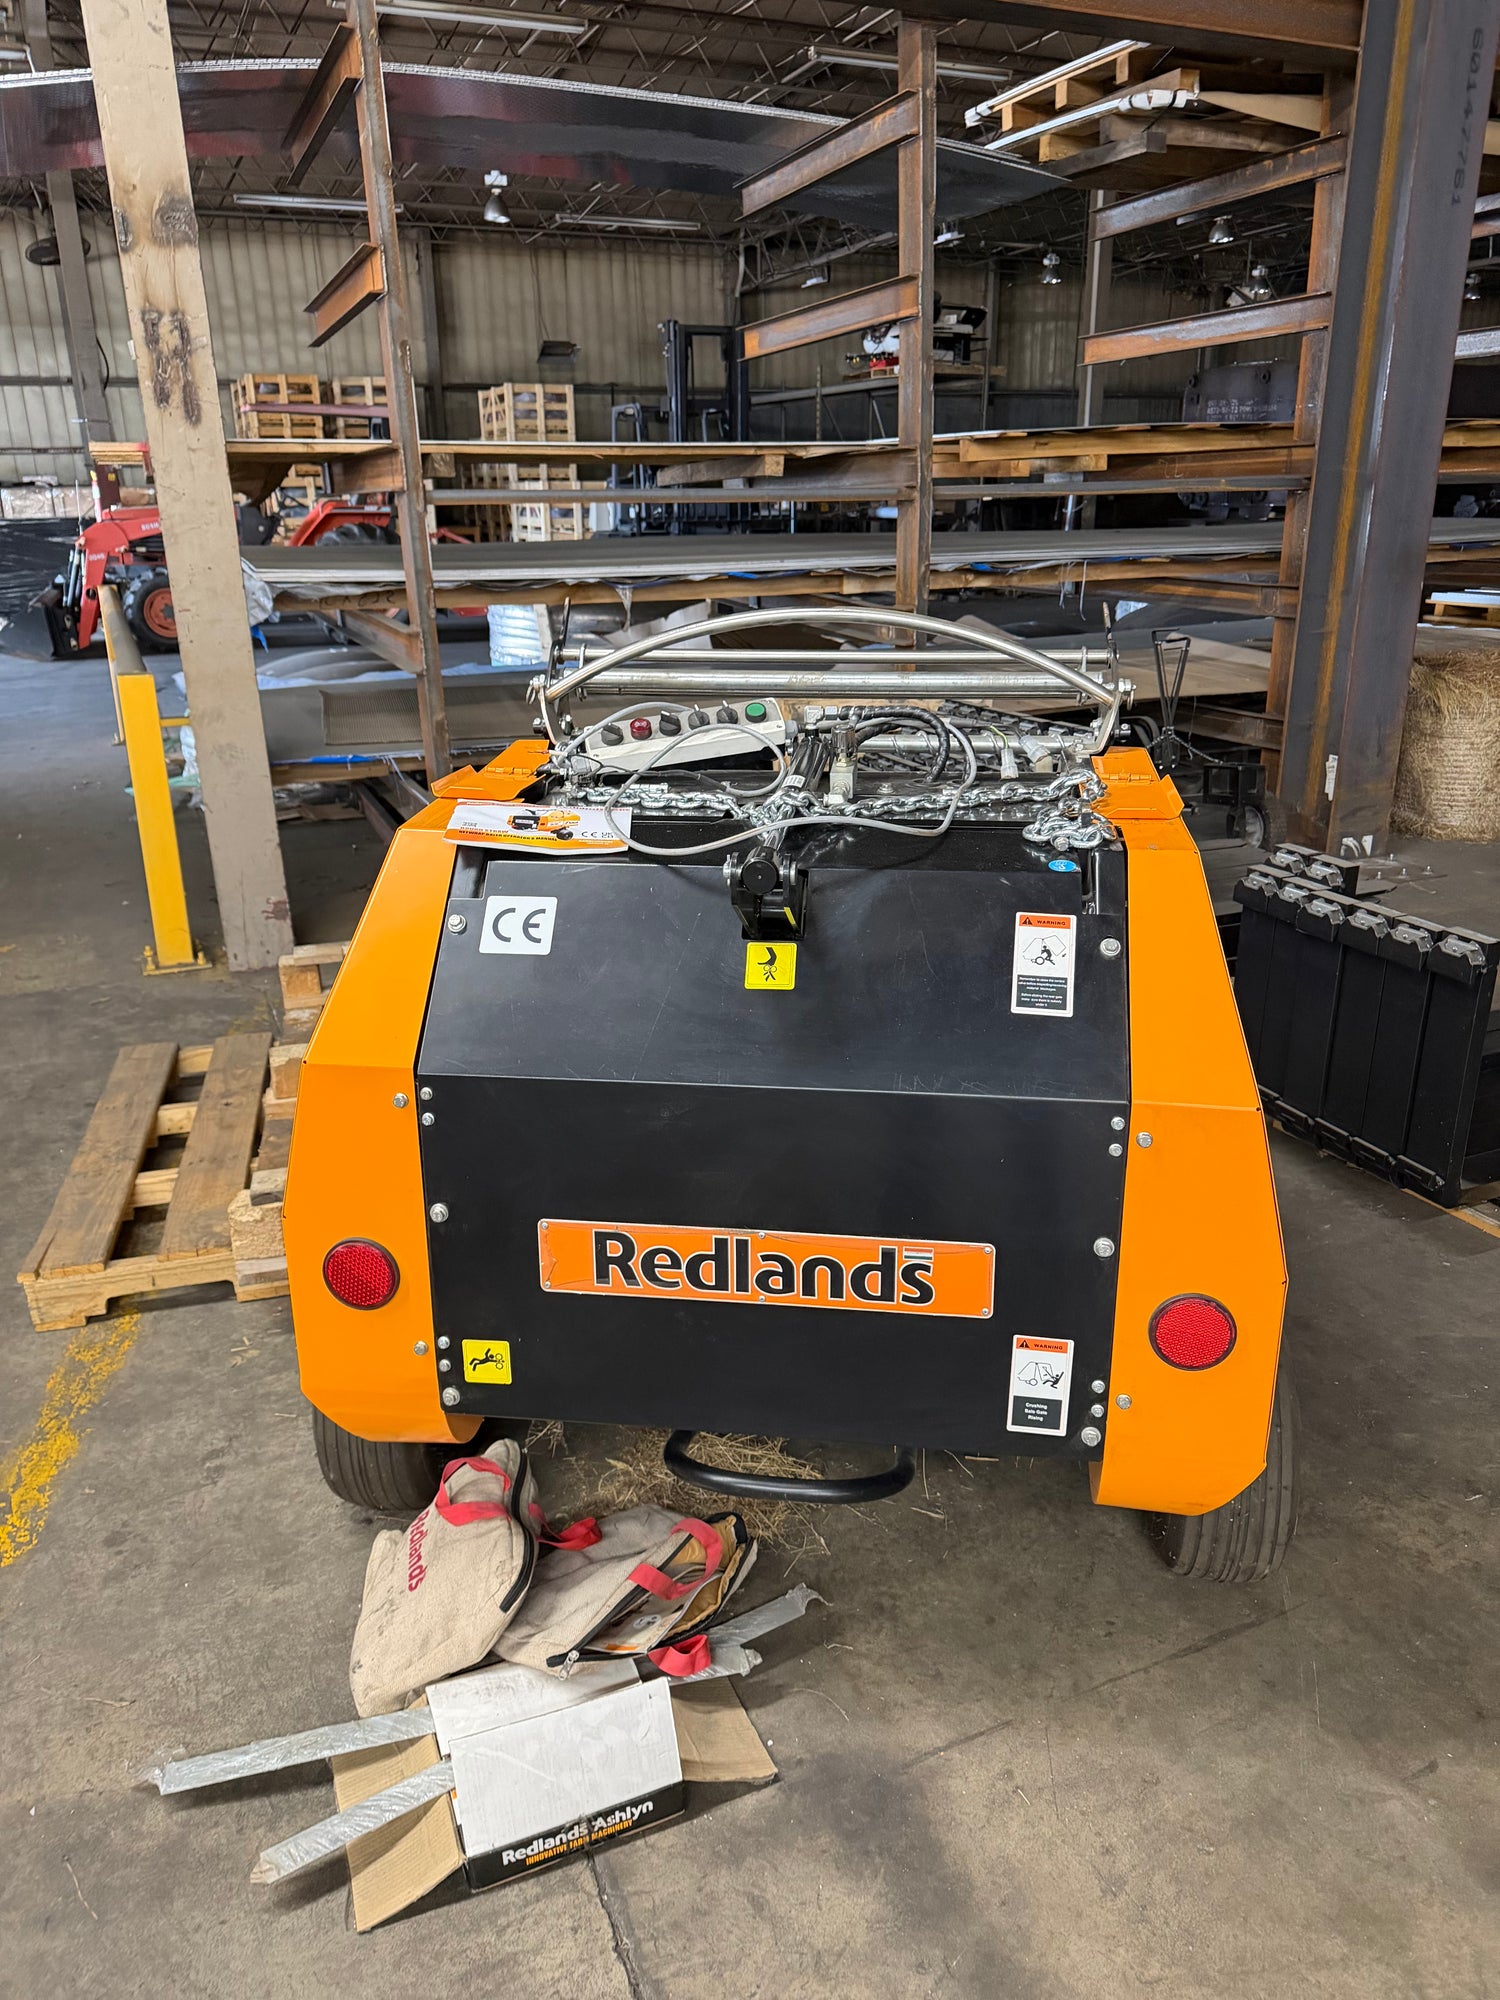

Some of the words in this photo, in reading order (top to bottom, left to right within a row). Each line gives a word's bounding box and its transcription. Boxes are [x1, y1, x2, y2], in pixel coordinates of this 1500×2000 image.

[492, 907, 547, 944] CE
[592, 1228, 935, 1306] Redlands
[1025, 1402, 1048, 1410] Crushing
[408, 1510, 429, 1592] Redlands
[502, 1824, 589, 1866] Redlands
[593, 1800, 654, 1832] Ashlyn
[526, 1844, 567, 1866] INNOVATIVE
[591, 1819, 633, 1842] MACHINERY
